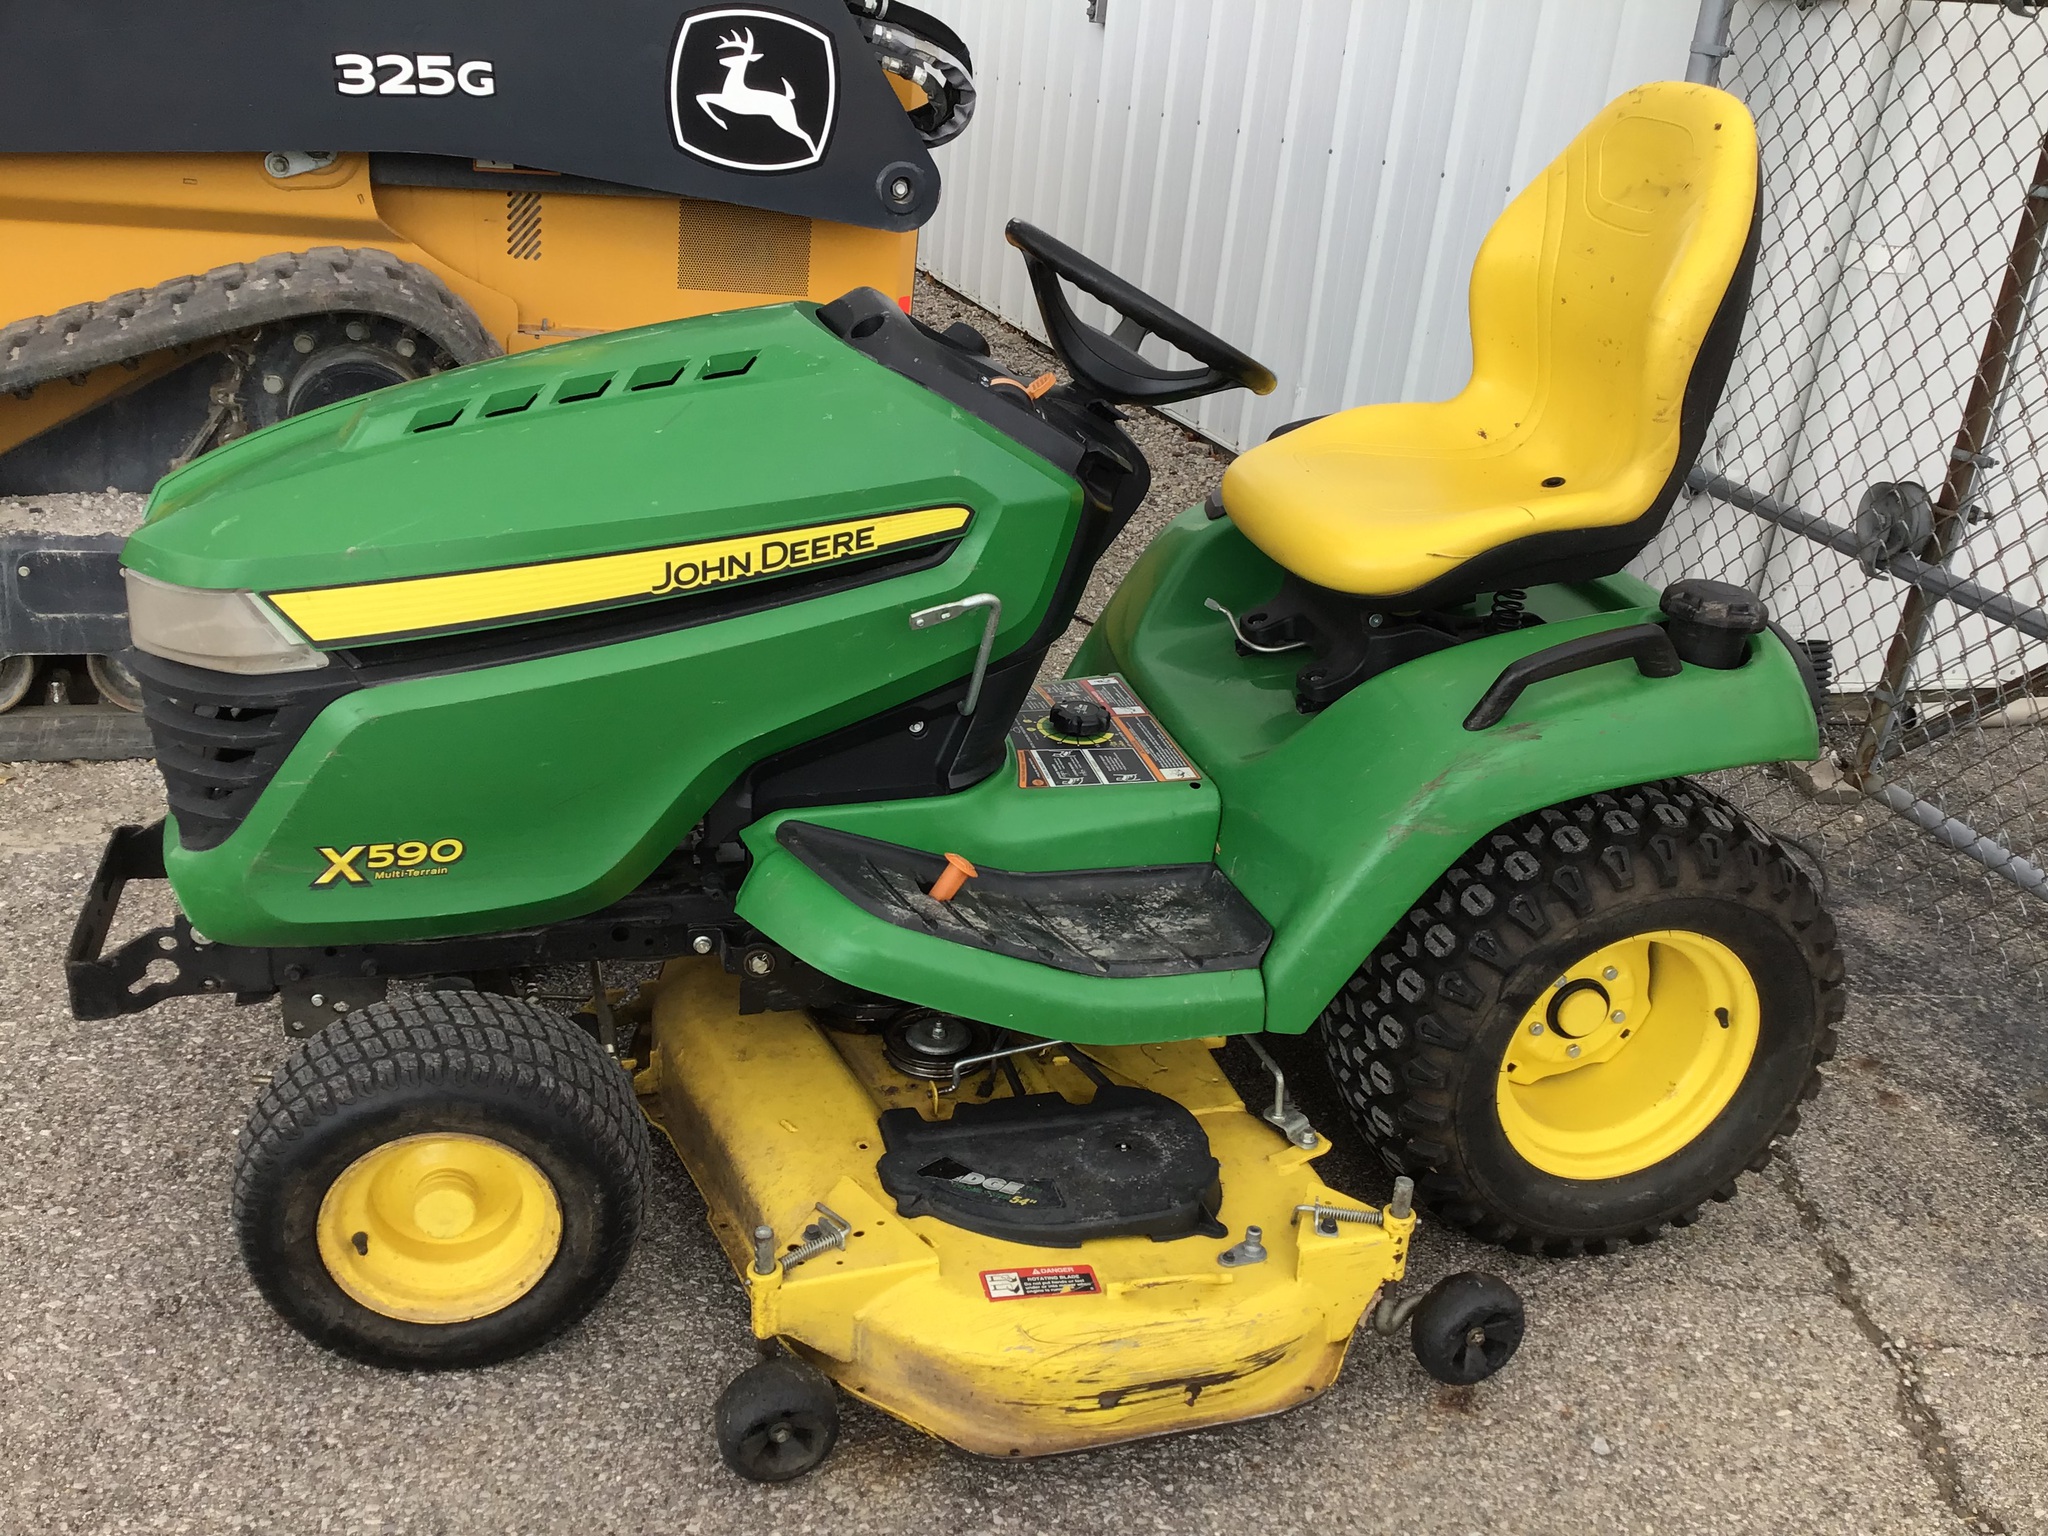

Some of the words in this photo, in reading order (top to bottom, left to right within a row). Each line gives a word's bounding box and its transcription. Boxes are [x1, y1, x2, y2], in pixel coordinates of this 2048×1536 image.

[333, 53, 496, 97] 325G
[652, 551, 751, 591] JOHN
[762, 526, 875, 570] DEERE
[311, 838, 465, 887] X590
[374, 867, 448, 880] Multi-Terrain
